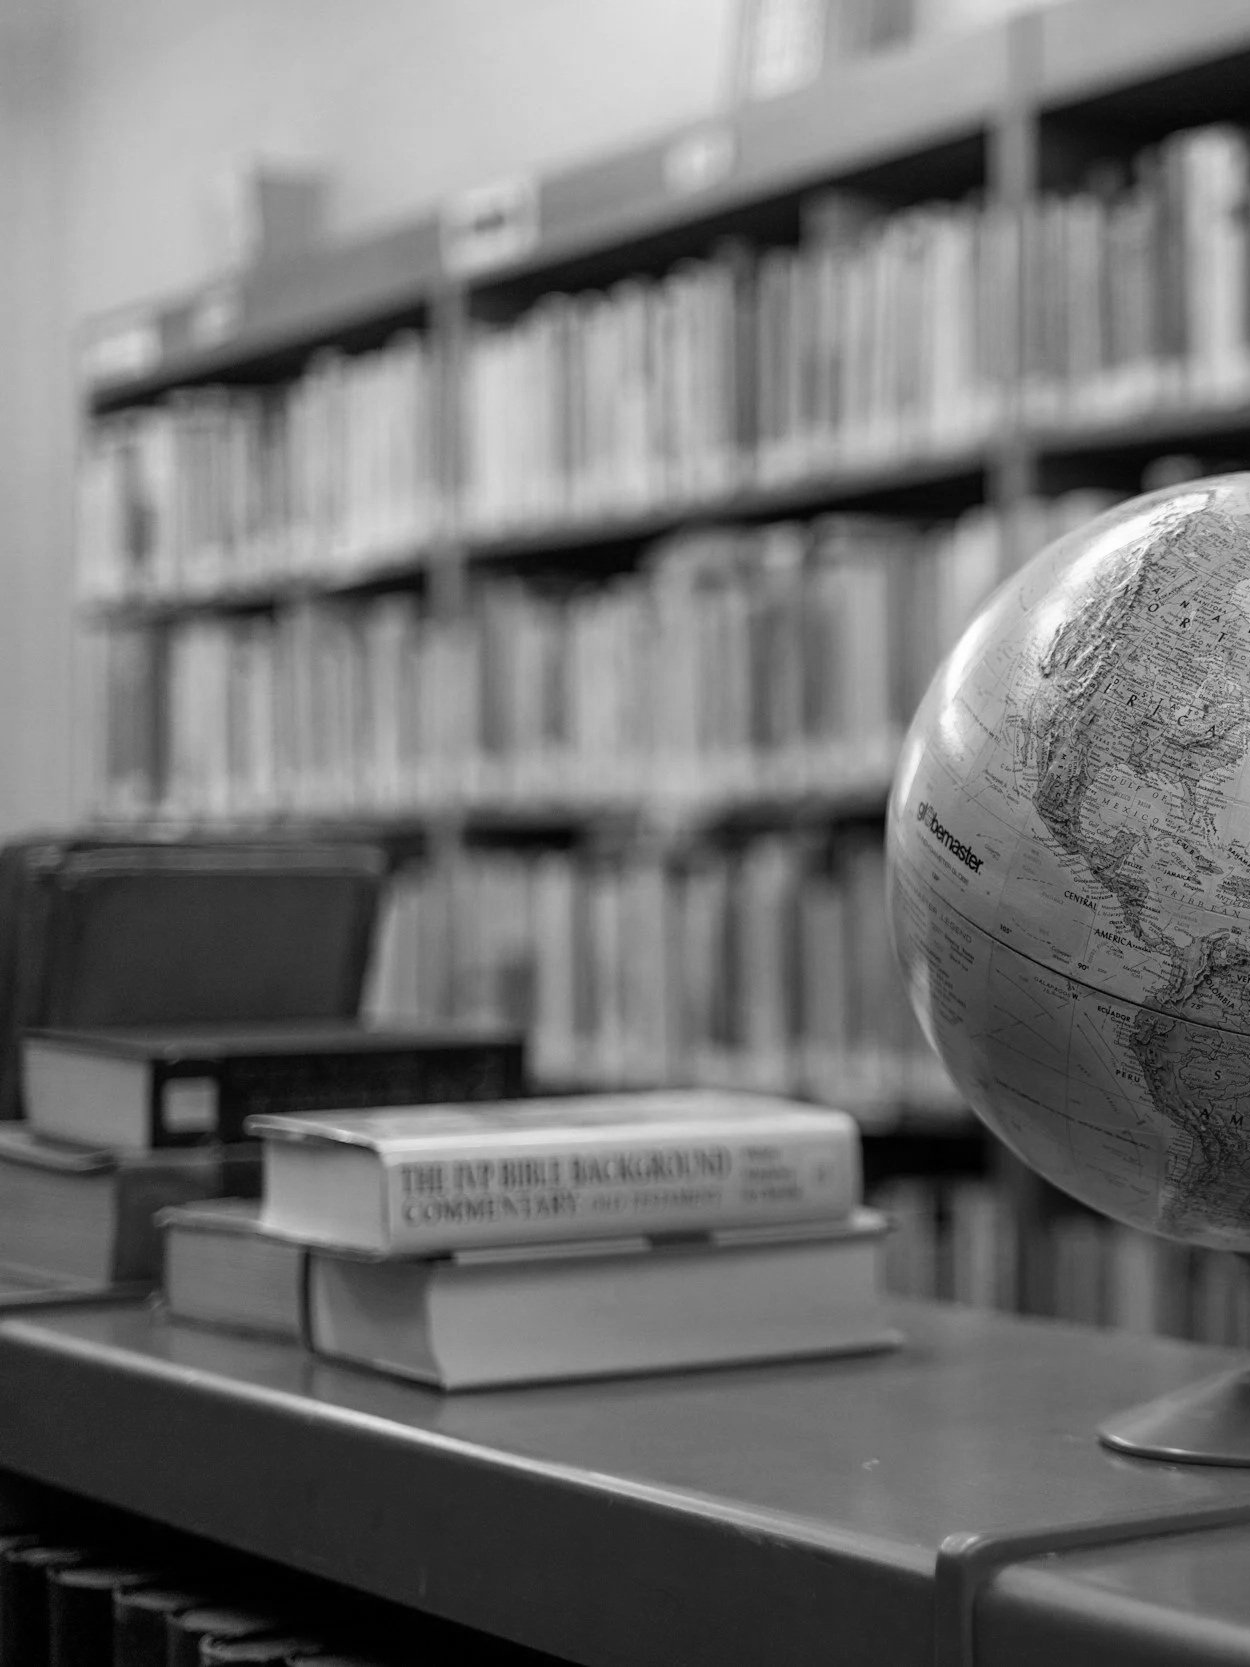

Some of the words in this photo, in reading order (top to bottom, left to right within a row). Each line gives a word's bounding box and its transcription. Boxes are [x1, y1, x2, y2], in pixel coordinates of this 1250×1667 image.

[1111, 774, 1142, 792] GULF
[1152, 791, 1168, 801] OF
[1102, 798, 1160, 825] MEXICO
[1163, 868, 1191, 882] JAMAICA
[1064, 890, 1097, 911] CENTRAL
[1155, 876, 1241, 919] CARIBBEAN
[1094, 928, 1133, 948] AMERICA
[1077, 962, 1090, 971] 90°
[1097, 1005, 1131, 1023] ECUADOR
[1115, 1069, 1140, 1083] PERU
[402, 1166, 443, 1195] THE
[573, 1146, 732, 1185] BACKGROUND
[405, 1191, 579, 1226] COMMENTARY
